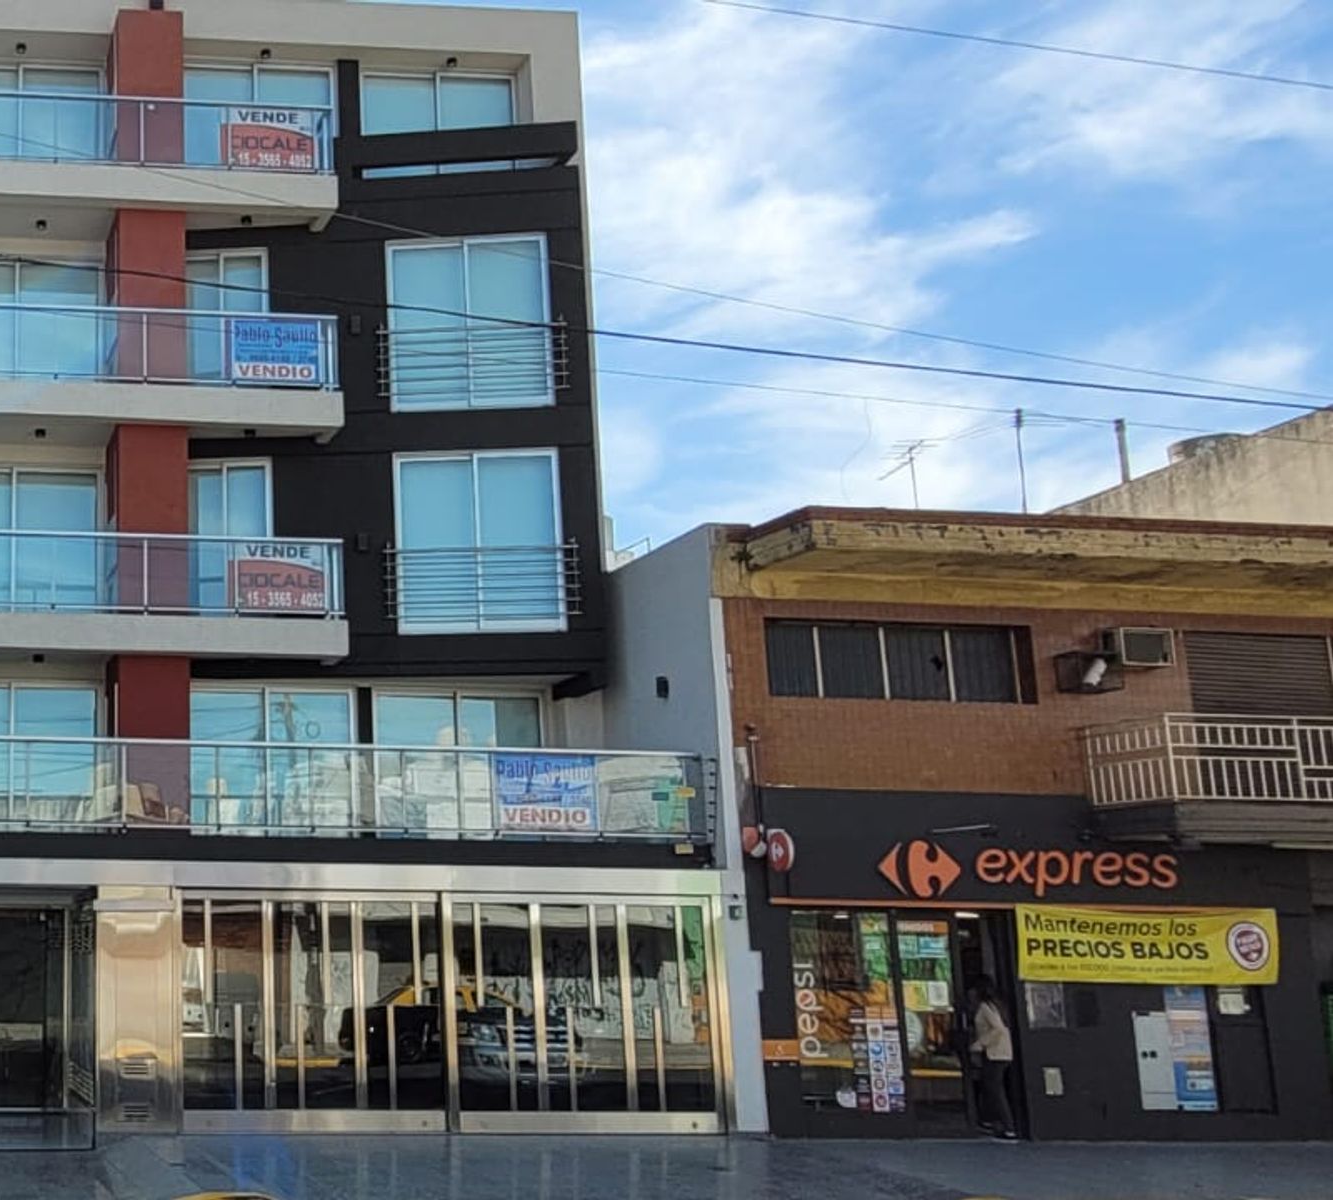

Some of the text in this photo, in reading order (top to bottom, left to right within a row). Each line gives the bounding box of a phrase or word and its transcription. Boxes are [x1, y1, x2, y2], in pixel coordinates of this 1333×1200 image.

[238, 110, 299, 124] VENDE
[234, 325, 270, 342] Pablo
[239, 364, 313, 379] VENDIO
[246, 544, 312, 559] VENDE
[248, 591, 260, 607] 15
[497, 760, 537, 779] Pablo
[505, 807, 587, 824] VENDIO
[976, 848, 1178, 897] express
[1024, 914, 1198, 937] Mantenemos los
[1026, 938, 1210, 960] PRECIOS BAJOS
[792, 963, 828, 1057] pepsi
